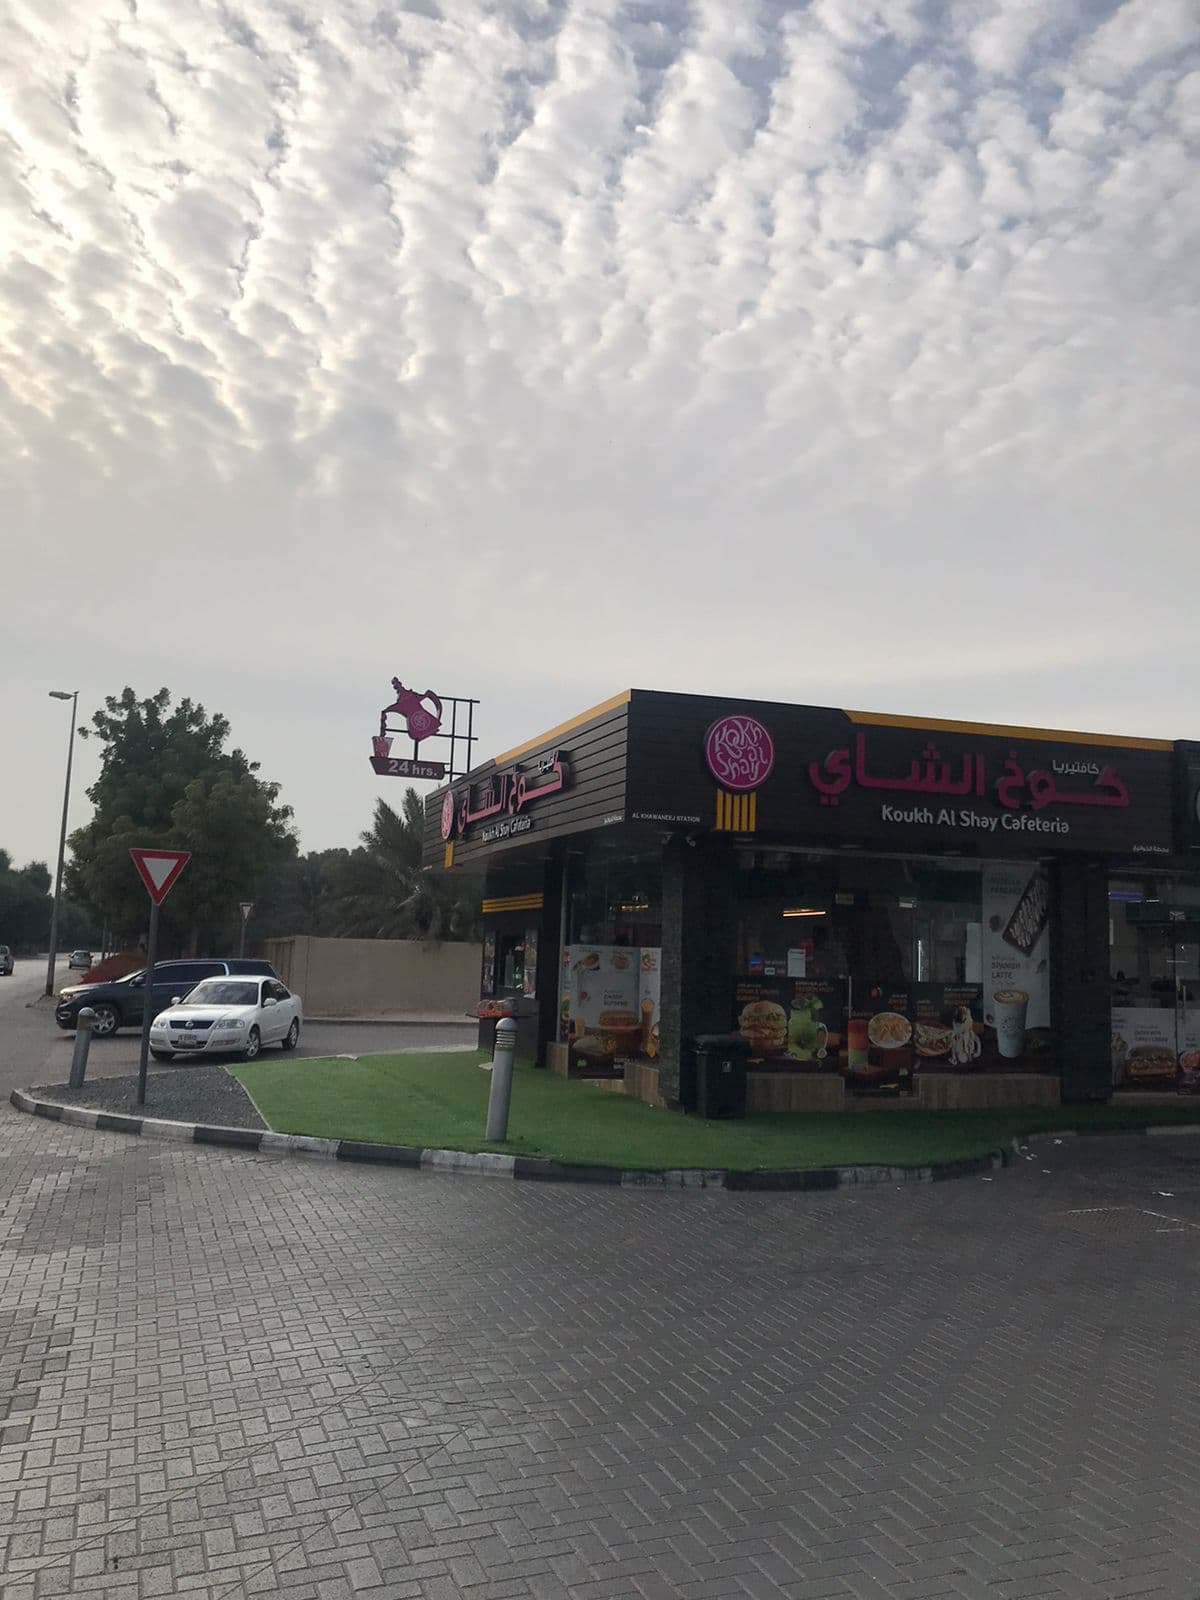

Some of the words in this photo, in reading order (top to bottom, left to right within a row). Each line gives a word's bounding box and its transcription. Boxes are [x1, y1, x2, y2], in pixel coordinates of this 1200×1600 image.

[388, 760, 409, 774] 24
[412, 764, 437, 776] hrs.
[809, 732, 985, 806] الشاي
[1053, 760, 1099, 774] كافتيريا
[998, 750, 1129, 810] كوخ
[676, 814, 700, 823] STATION
[882, 804, 934, 825] Koukh
[937, 808, 956, 826] Al
[959, 810, 998, 832] Shay
[1001, 813, 1070, 834] Cafeteria
